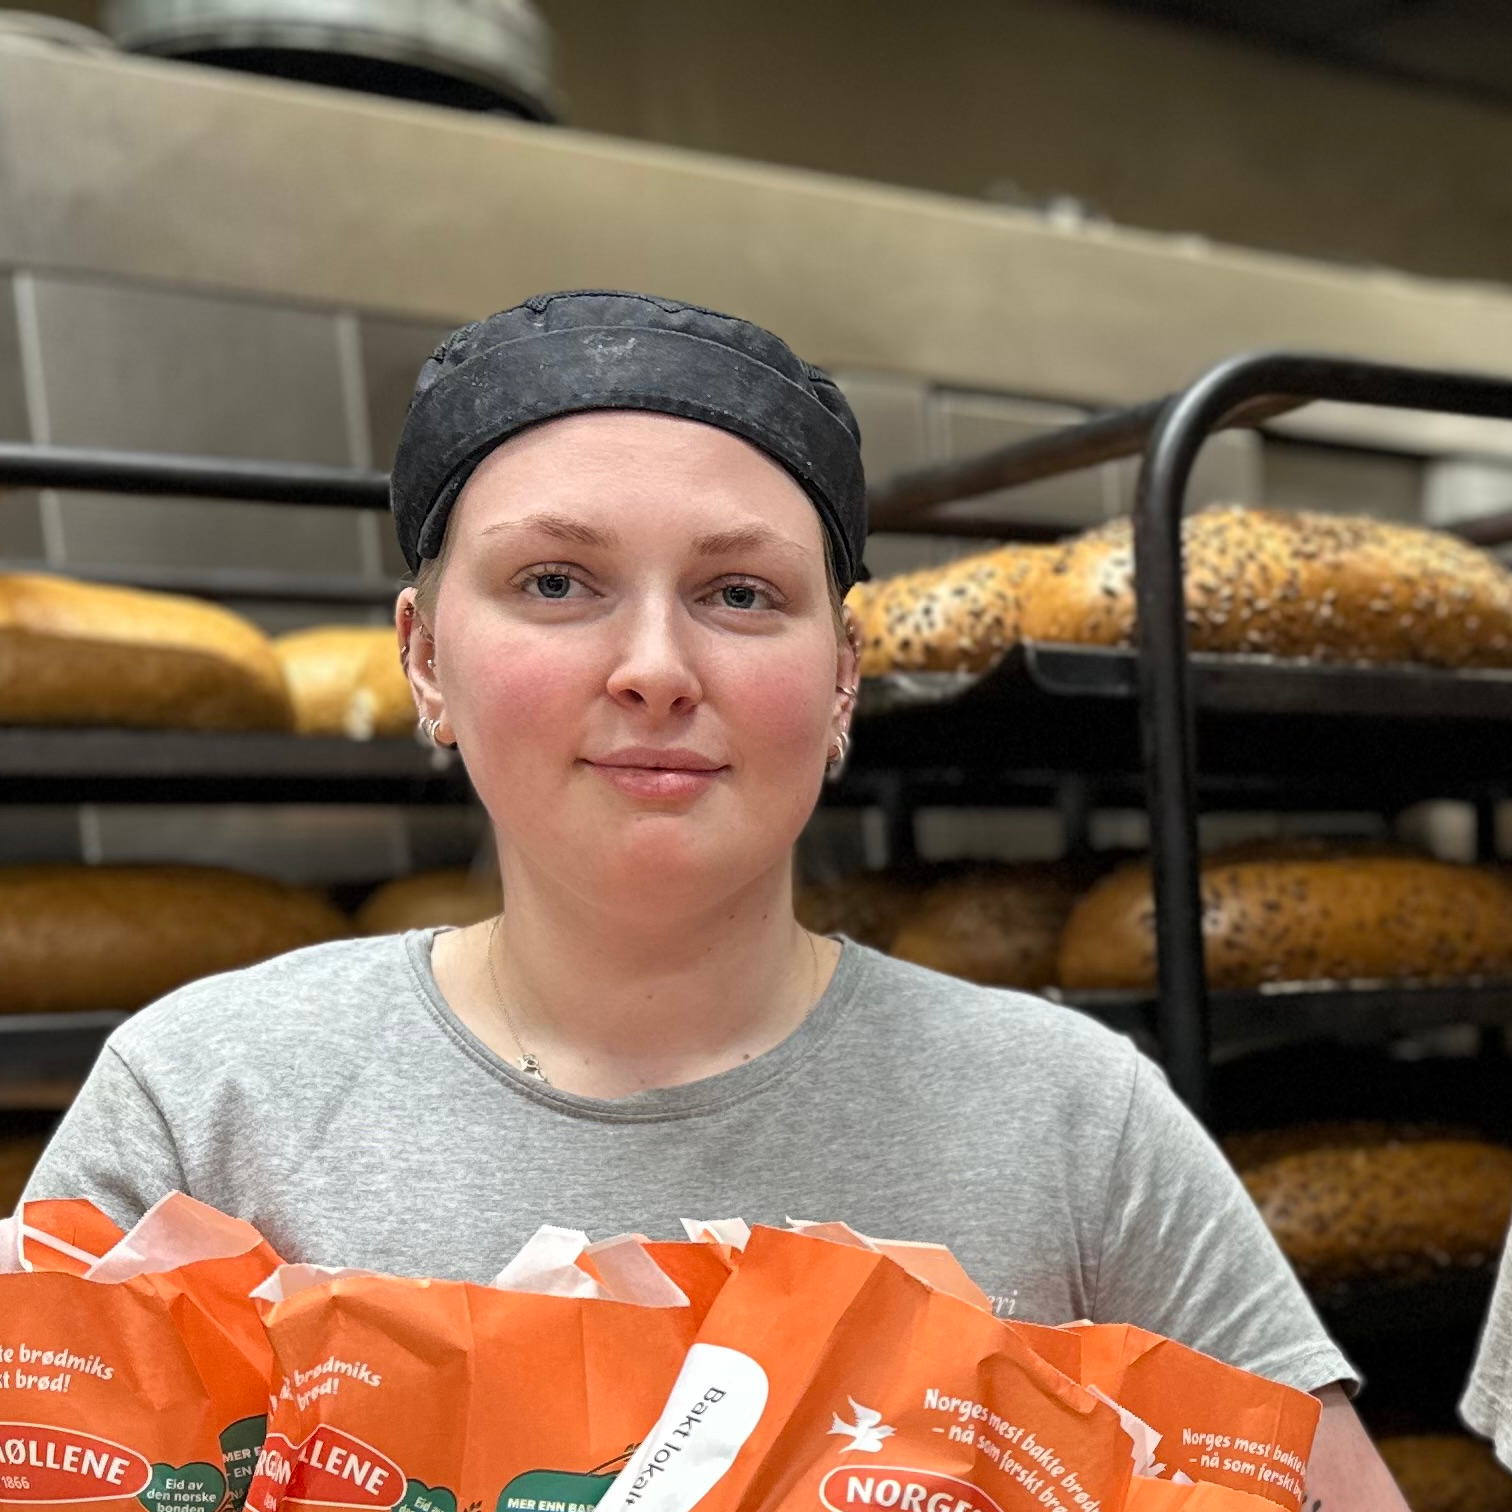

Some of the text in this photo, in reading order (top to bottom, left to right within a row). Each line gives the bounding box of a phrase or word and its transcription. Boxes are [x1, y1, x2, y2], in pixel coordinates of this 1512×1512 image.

[19, 1343, 115, 1381] brødmiks
[294, 1356, 382, 1387] brødmiks
[15, 1369, 72, 1393] brød!
[297, 1378, 339, 1411] brød!
[672, 1385, 726, 1438] Bakt
[923, 1387, 989, 1422] Norges
[988, 1410, 1022, 1442] mest
[1020, 1432, 1066, 1479] bakte
[949, 1424, 975, 1445] nå
[978, 1435, 1002, 1463] som
[999, 1449, 1044, 1500] ferskt
[1182, 1428, 1303, 1473] Norges mest bakte
[166, 1479, 203, 1490] Eid av
[1201, 1452, 1294, 1492] nå som ferskt
[146, 1489, 171, 1501] den
[174, 1491, 217, 1503] norske
[414, 1497, 430, 1512] Eid
[507, 1498, 535, 1509] MER
[538, 1500, 565, 1512] ENN
